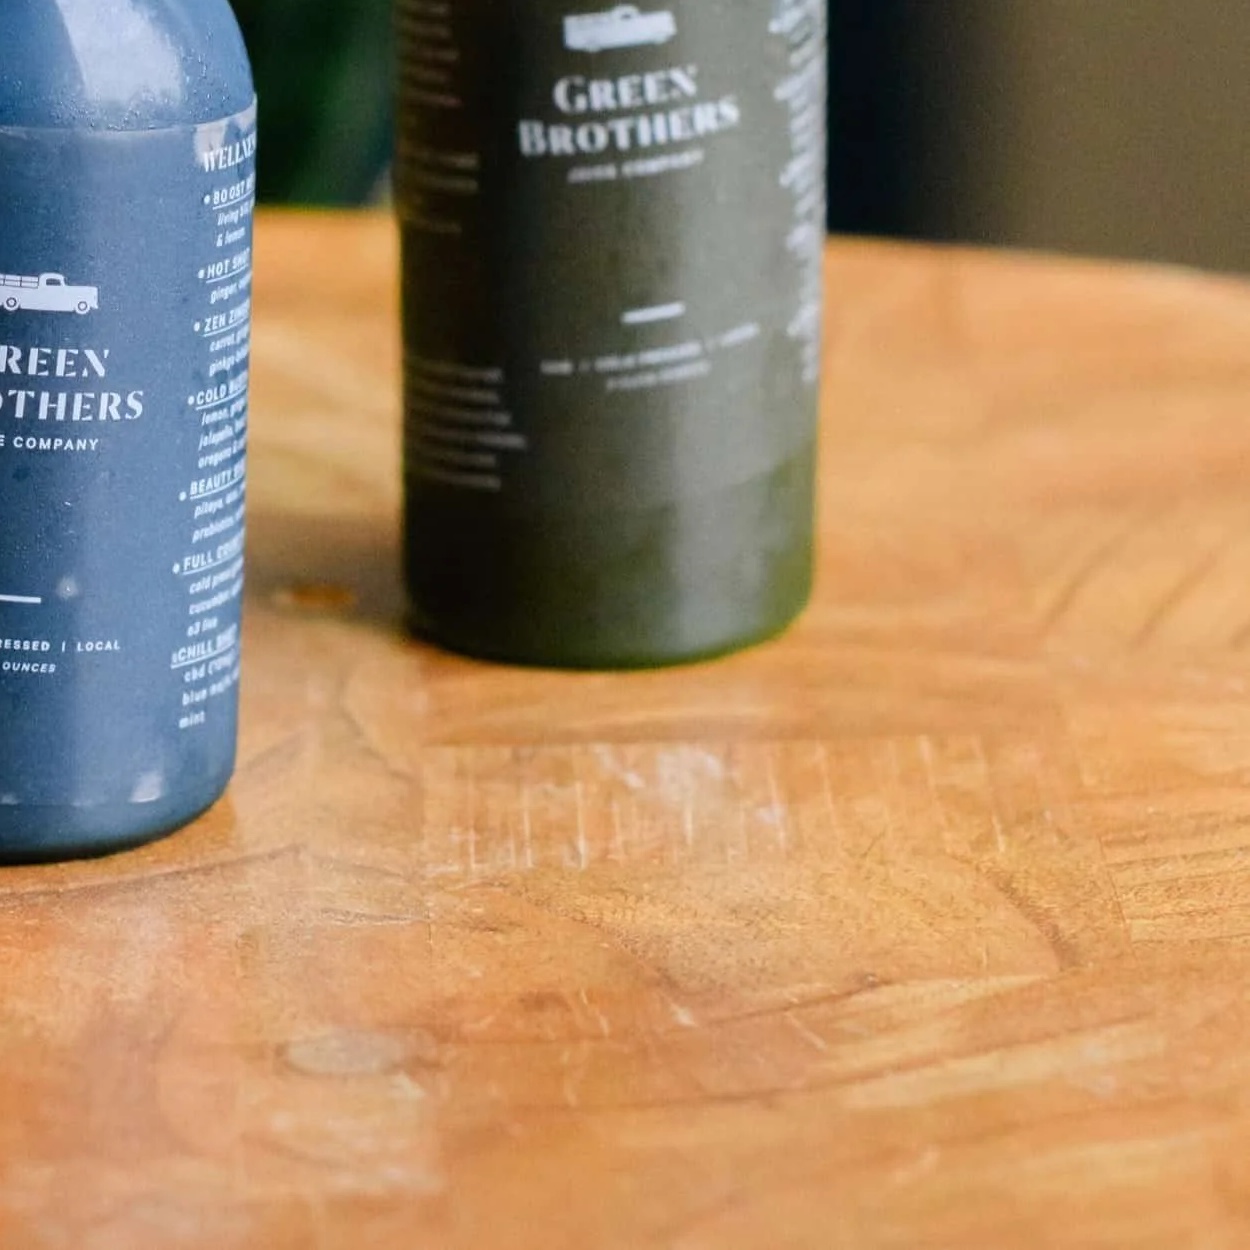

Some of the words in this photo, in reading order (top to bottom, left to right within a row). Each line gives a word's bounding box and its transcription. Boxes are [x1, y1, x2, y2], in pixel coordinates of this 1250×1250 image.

[553, 63, 700, 115] GREEN
[517, 94, 742, 157] BROTHERS
[206, 258, 231, 280] HOT
[204, 312, 227, 333] ZEN
[196, 382, 228, 406] COLD
[12, 436, 100, 451] COMPANY
[183, 549, 213, 573] FULL
[76, 639, 122, 653] LOCAL
[1, 661, 57, 674] OUNCES
